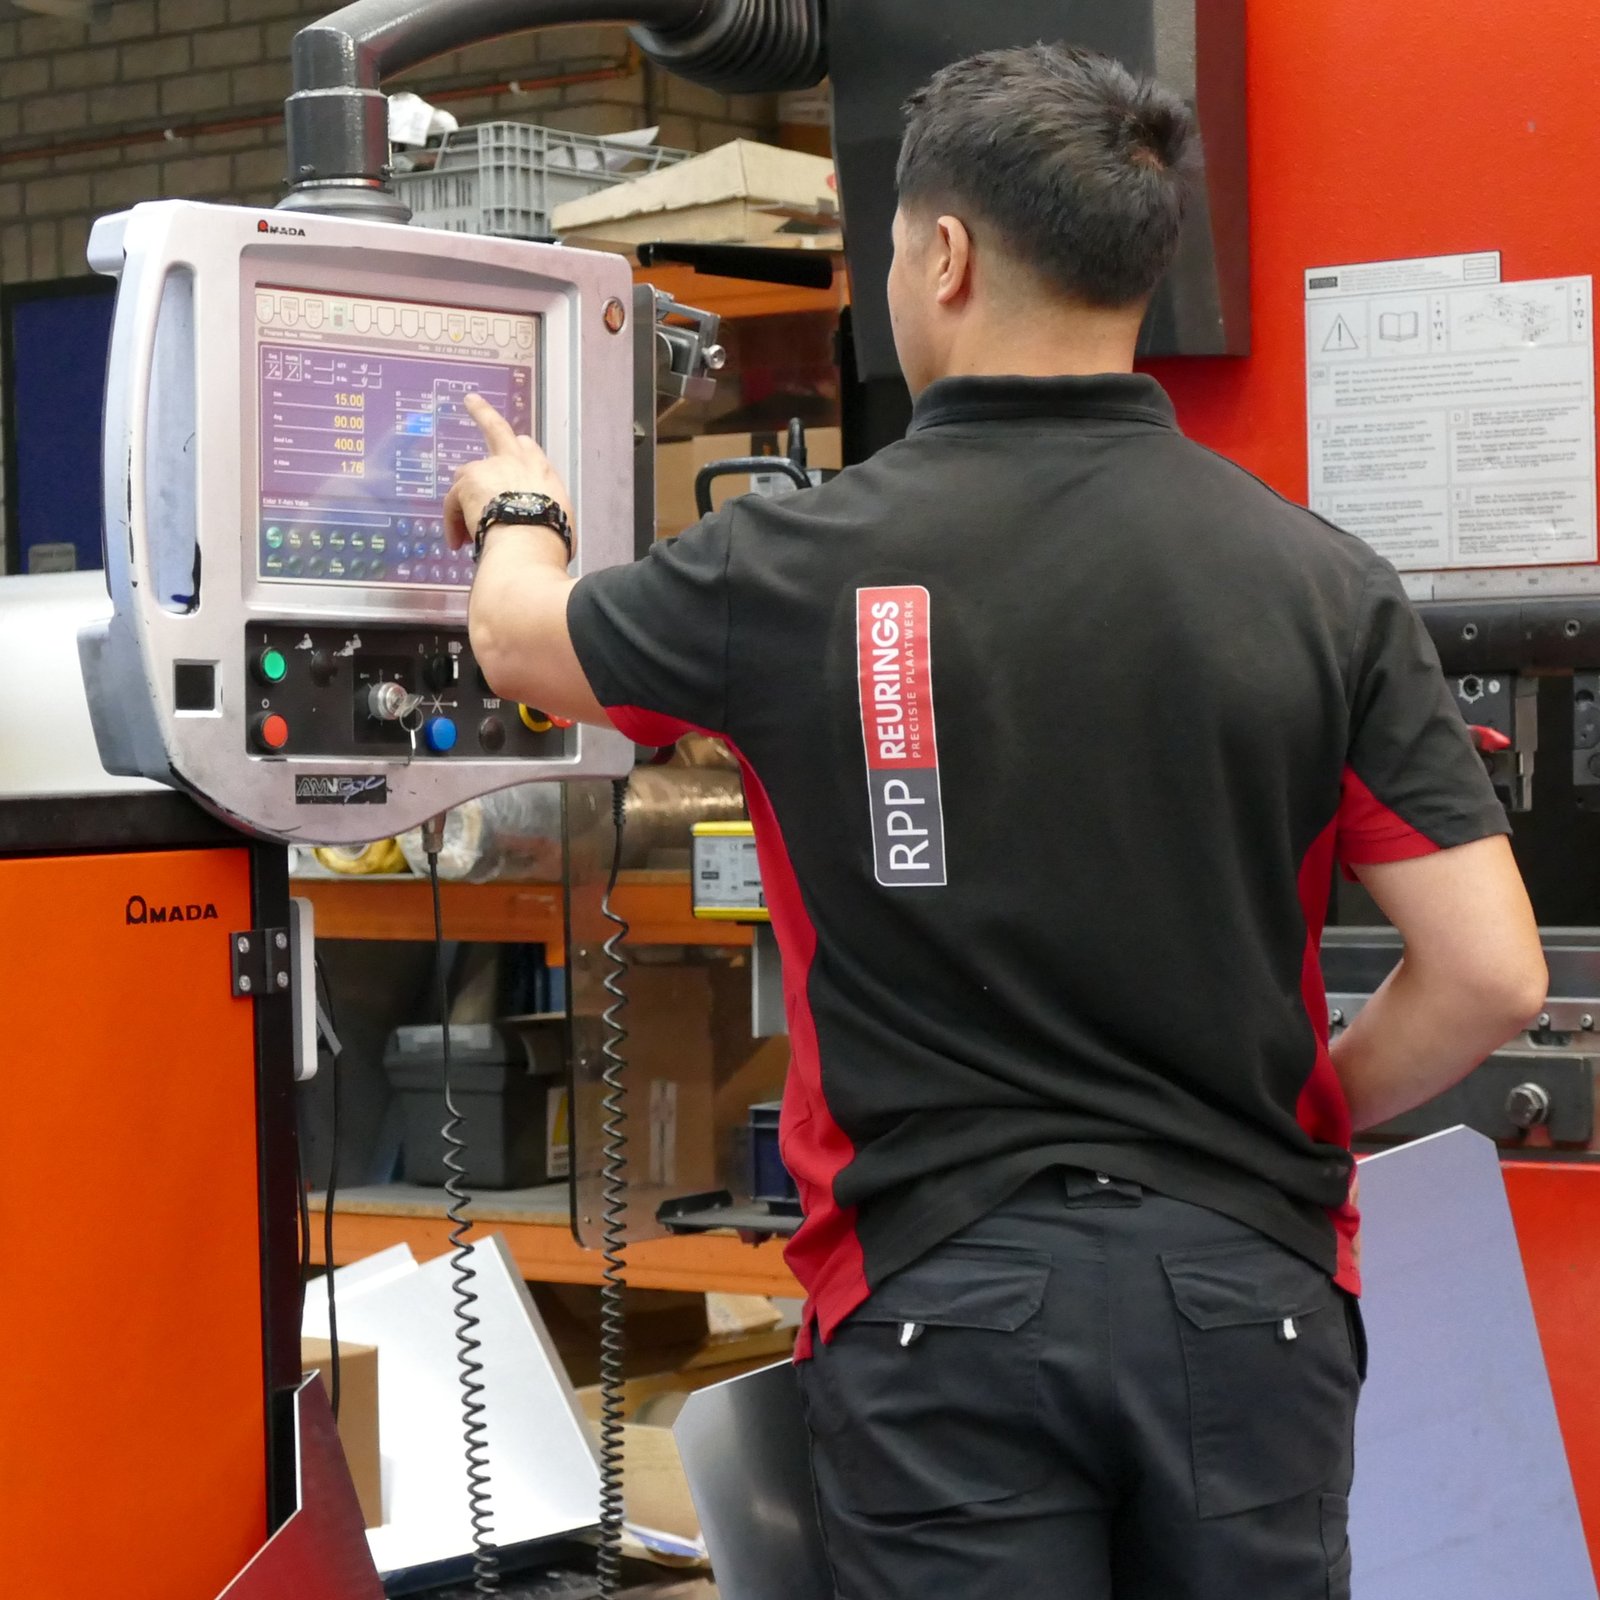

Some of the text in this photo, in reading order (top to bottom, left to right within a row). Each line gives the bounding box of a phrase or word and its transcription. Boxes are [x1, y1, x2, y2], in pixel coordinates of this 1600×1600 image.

[257, 219, 306, 237] AMADA
[334, 393, 363, 407] 15.00
[334, 415, 363, 430] 90.00
[334, 438, 363, 452] 400.0
[871, 601, 907, 759] REURINGS
[904, 600, 922, 759] PRECISIE PLAATWERK
[483, 698, 501, 709] TEST
[883, 779, 930, 870] RPP
[125, 895, 219, 925] AMADA
